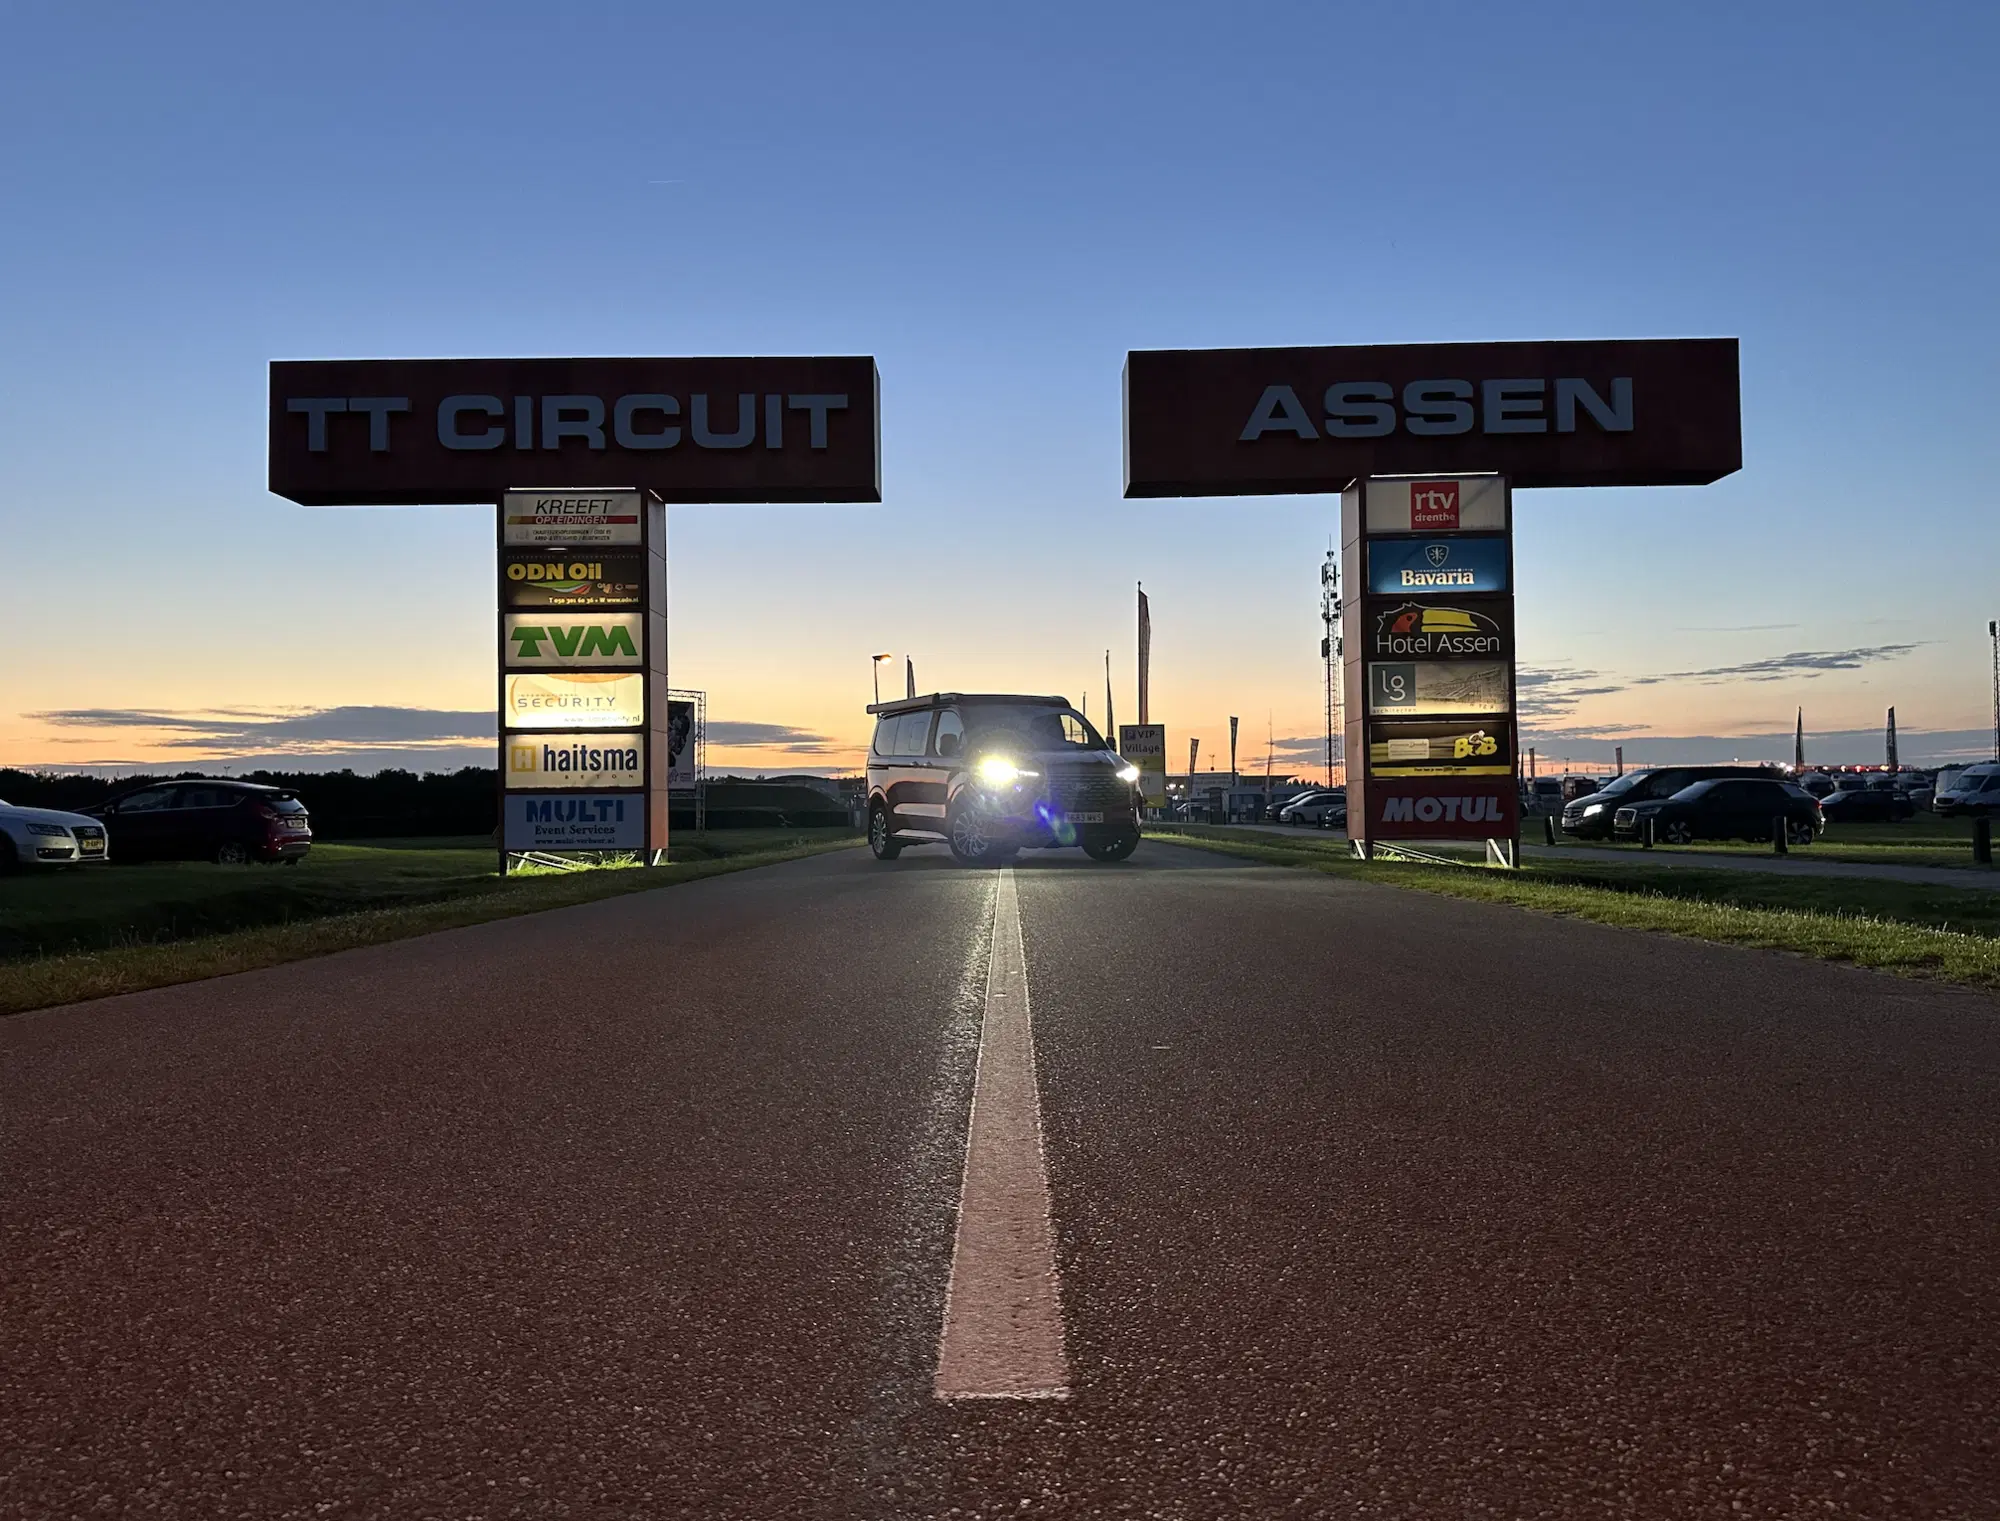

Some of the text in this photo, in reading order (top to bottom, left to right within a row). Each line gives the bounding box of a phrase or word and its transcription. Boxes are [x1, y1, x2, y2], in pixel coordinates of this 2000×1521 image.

[1238, 376, 1635, 441] ASSEN
[287, 393, 849, 452] TT CIRCUIT
[535, 499, 613, 515] KREEFT
[1415, 489, 1455, 510] rtv
[535, 515, 608, 525] OPLEIDINGEN
[1415, 513, 1456, 522] drenthe
[507, 562, 602, 581] ODN Oil
[1400, 568, 1475, 586] Bavaria
[510, 625, 638, 658] TVM
[1377, 632, 1500, 654] Hotel Assen
[517, 697, 616, 708] SECURITY
[543, 743, 638, 772] haitsma
[1125, 743, 1160, 755] Village
[526, 799, 624, 823] MULTI
[1381, 796, 1504, 823] MOTUL
[535, 824, 616, 835] Event Services
